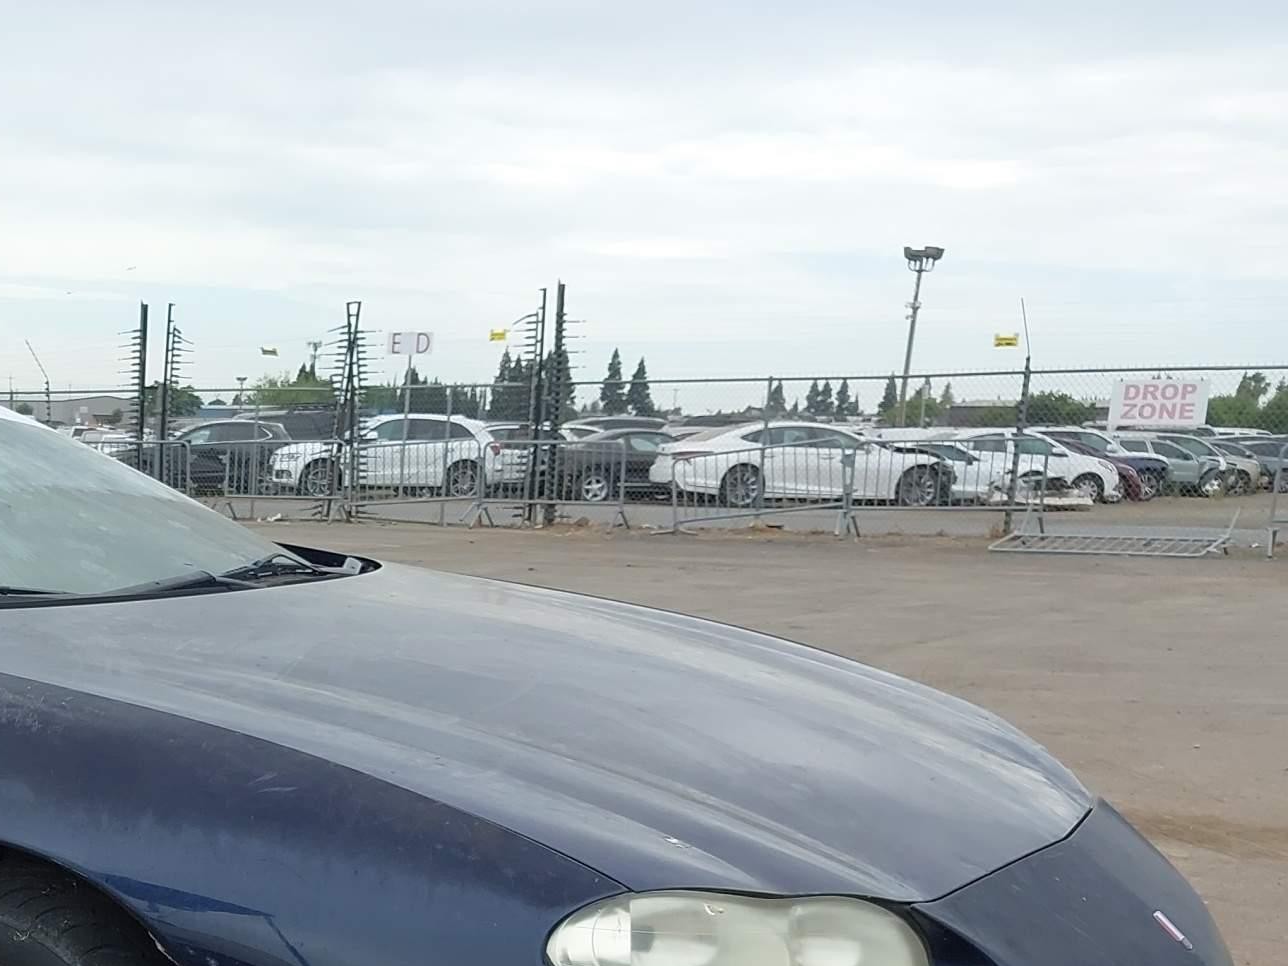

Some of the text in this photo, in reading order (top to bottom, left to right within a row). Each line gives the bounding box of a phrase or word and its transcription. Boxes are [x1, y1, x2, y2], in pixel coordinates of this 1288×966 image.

[392, 333, 430, 354] E D
[1123, 383, 1198, 401] DROP
[1120, 402, 1196, 420] ZONE
